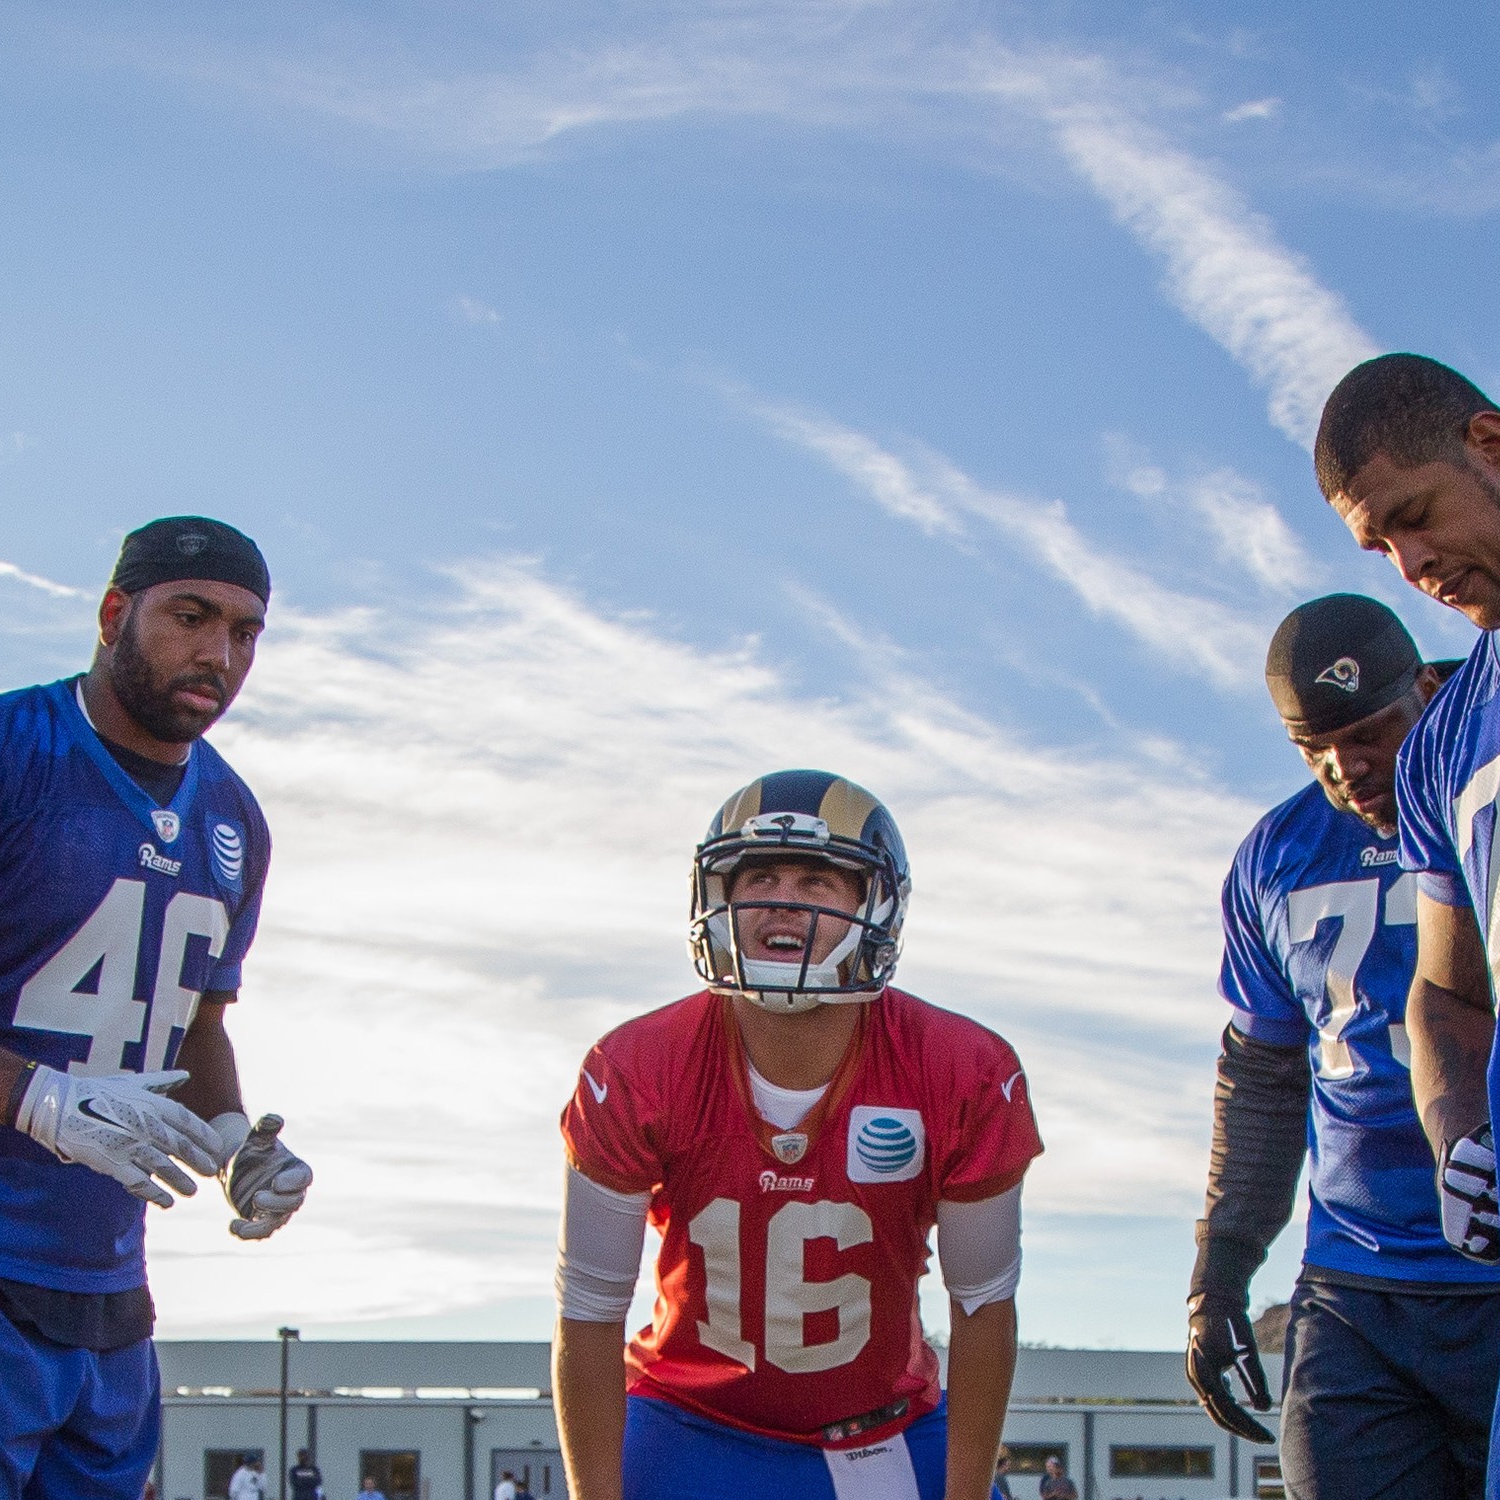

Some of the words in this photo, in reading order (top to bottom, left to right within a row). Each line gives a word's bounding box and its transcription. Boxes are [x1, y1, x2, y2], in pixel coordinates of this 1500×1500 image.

[139, 843, 182, 877] Rams
[1361, 847, 1397, 867] Ram
[759, 1171, 815, 1193] Rams
[689, 1197, 874, 1374] 16
